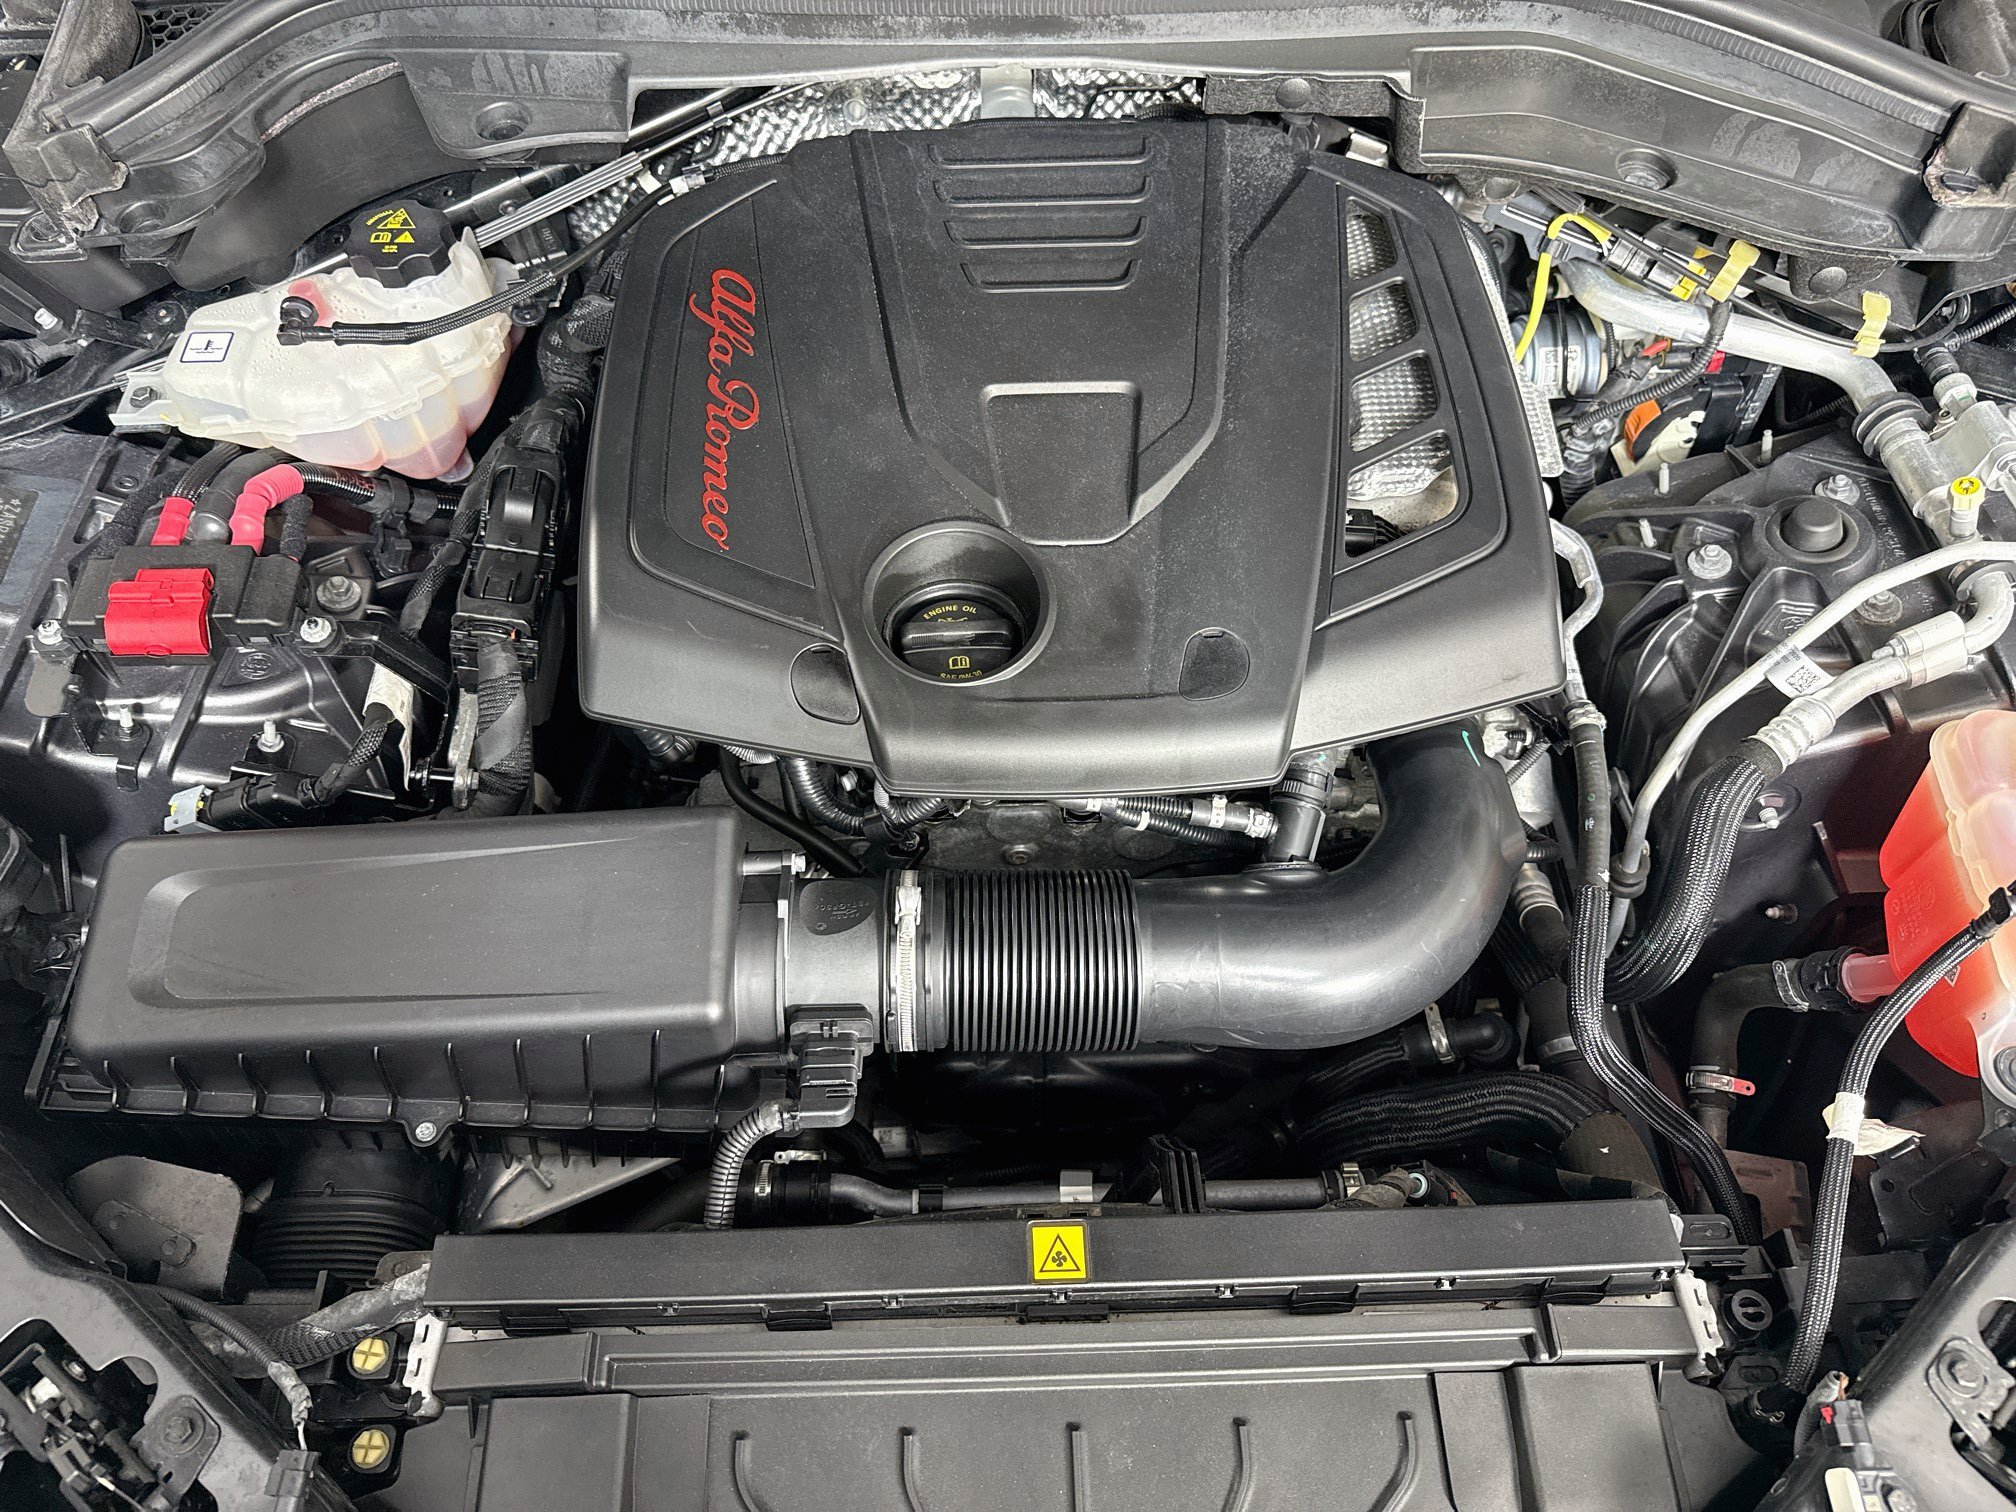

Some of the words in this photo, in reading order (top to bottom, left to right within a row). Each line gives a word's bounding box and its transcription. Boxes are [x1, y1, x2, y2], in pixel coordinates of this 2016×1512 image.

[689, 269, 756, 374] Alfa
[701, 372, 760, 550] Romeo
[923, 605, 958, 620] ENGINE
[962, 605, 977, 614] OIL
